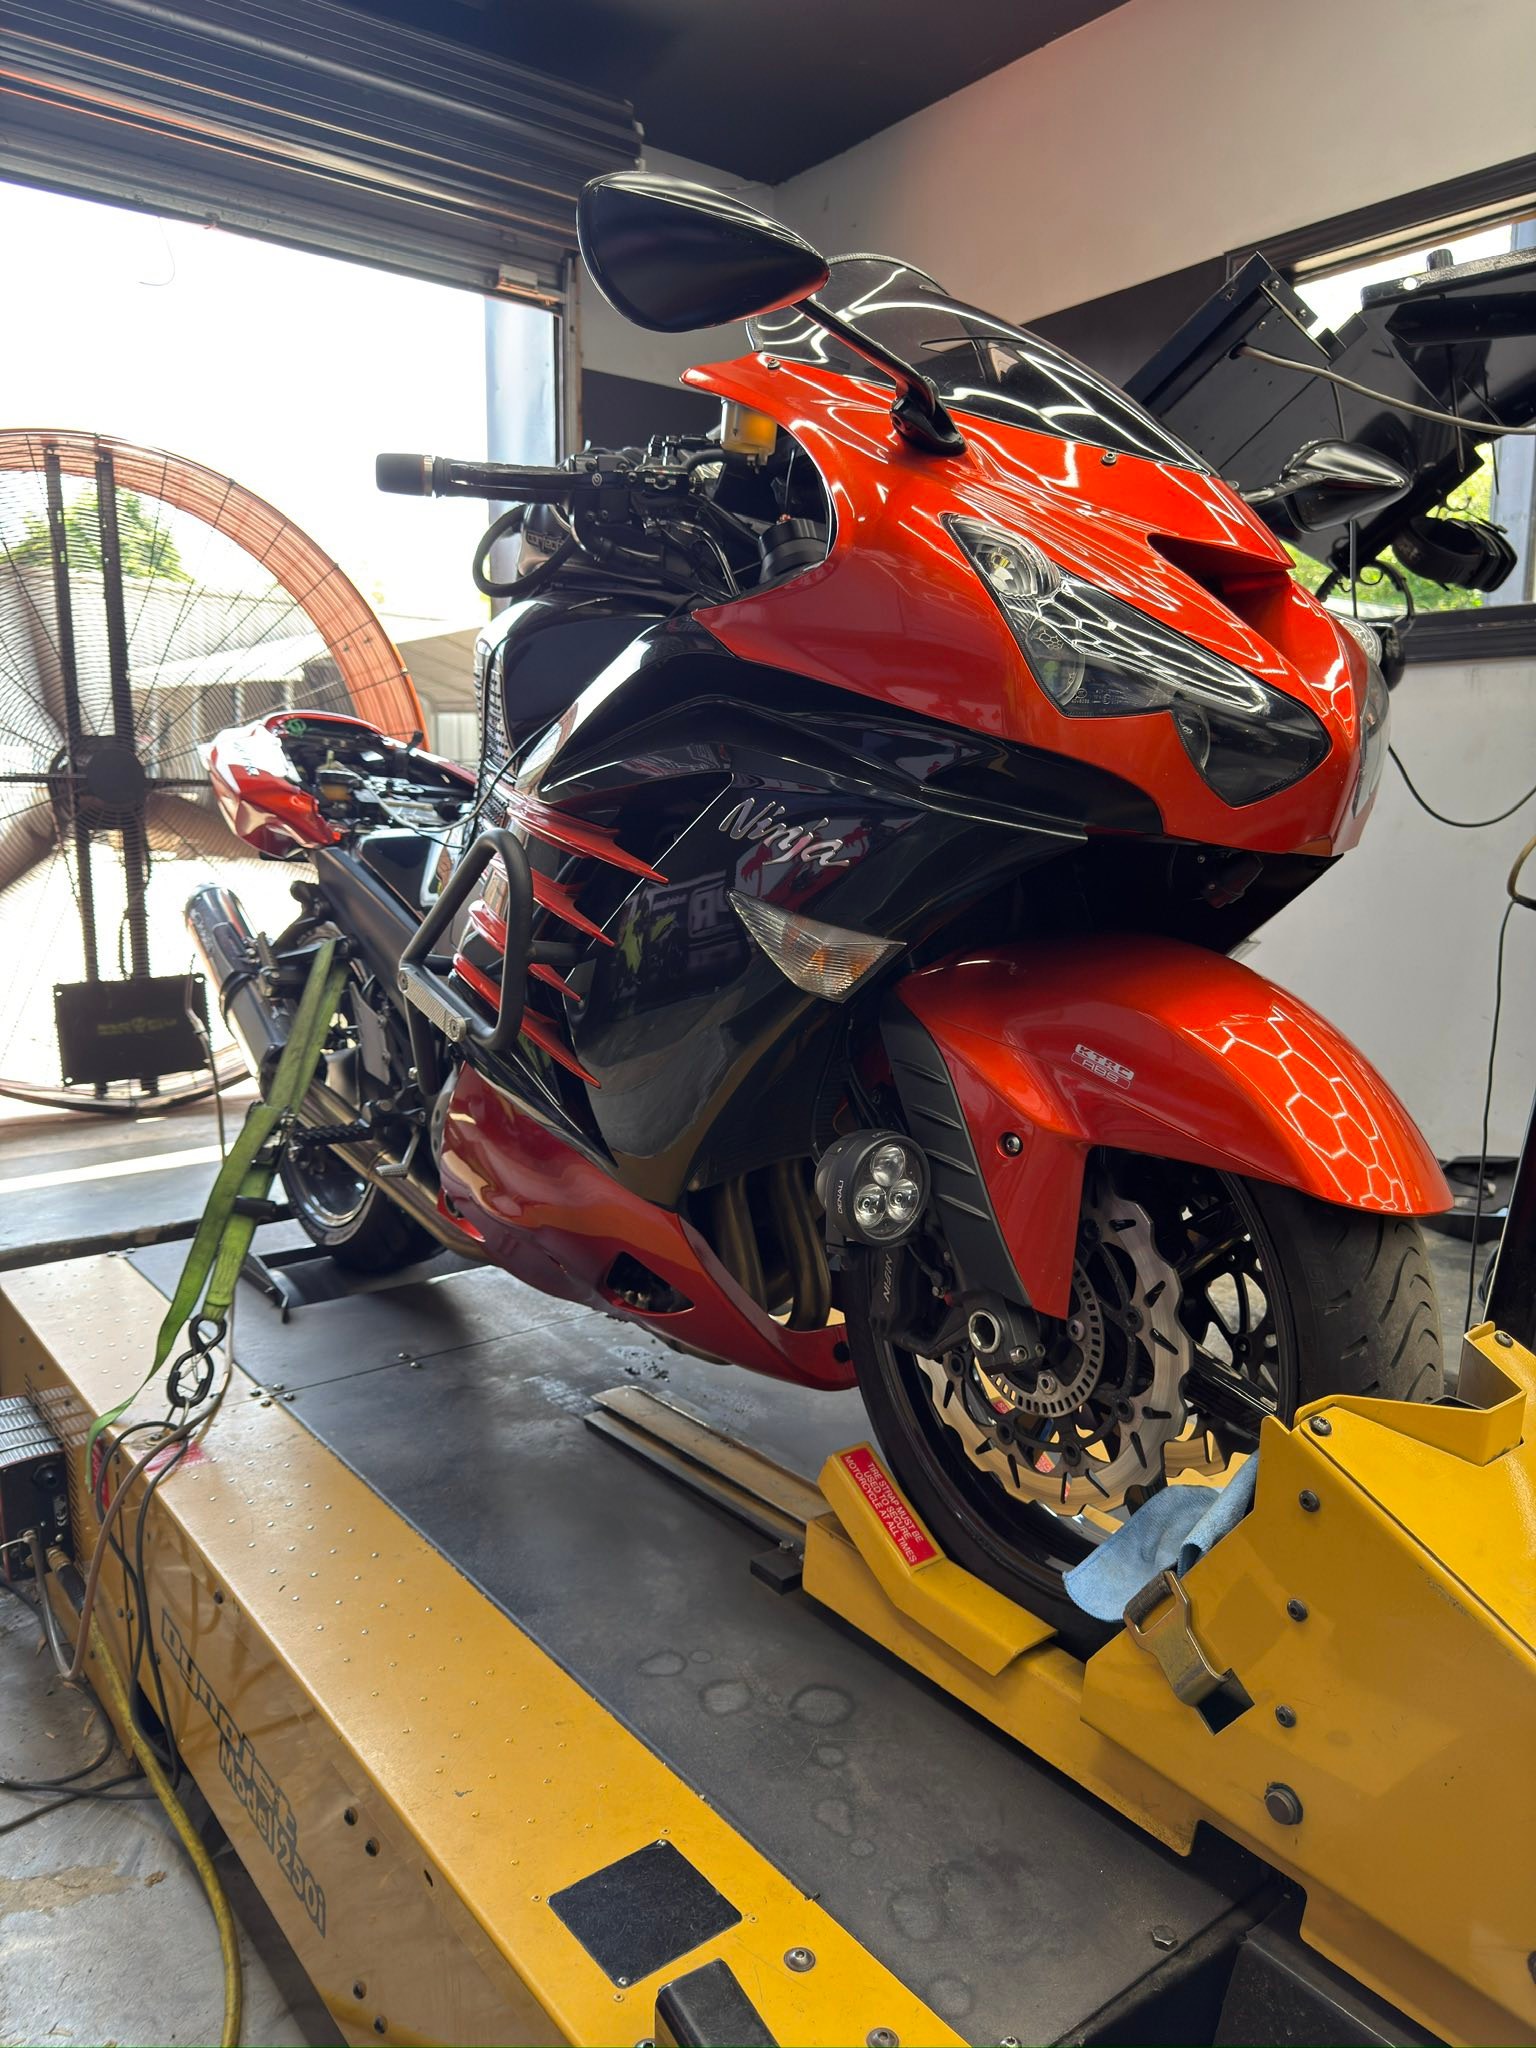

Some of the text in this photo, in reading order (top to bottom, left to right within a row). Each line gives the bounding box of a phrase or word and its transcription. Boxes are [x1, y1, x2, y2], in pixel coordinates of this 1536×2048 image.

[718, 797, 850, 867] Ninja
[1078, 1046, 1131, 1078] KTRC
[1082, 1059, 1121, 1083] ABS
[844, 1455, 918, 1563] MOTORCYCLE AT ALL TIMES
[863, 1471, 912, 1539] USED TO SECURE
[868, 1462, 924, 1543] TIRE STRAP MUST BE
[219, 1730, 326, 1938] Model 250i
